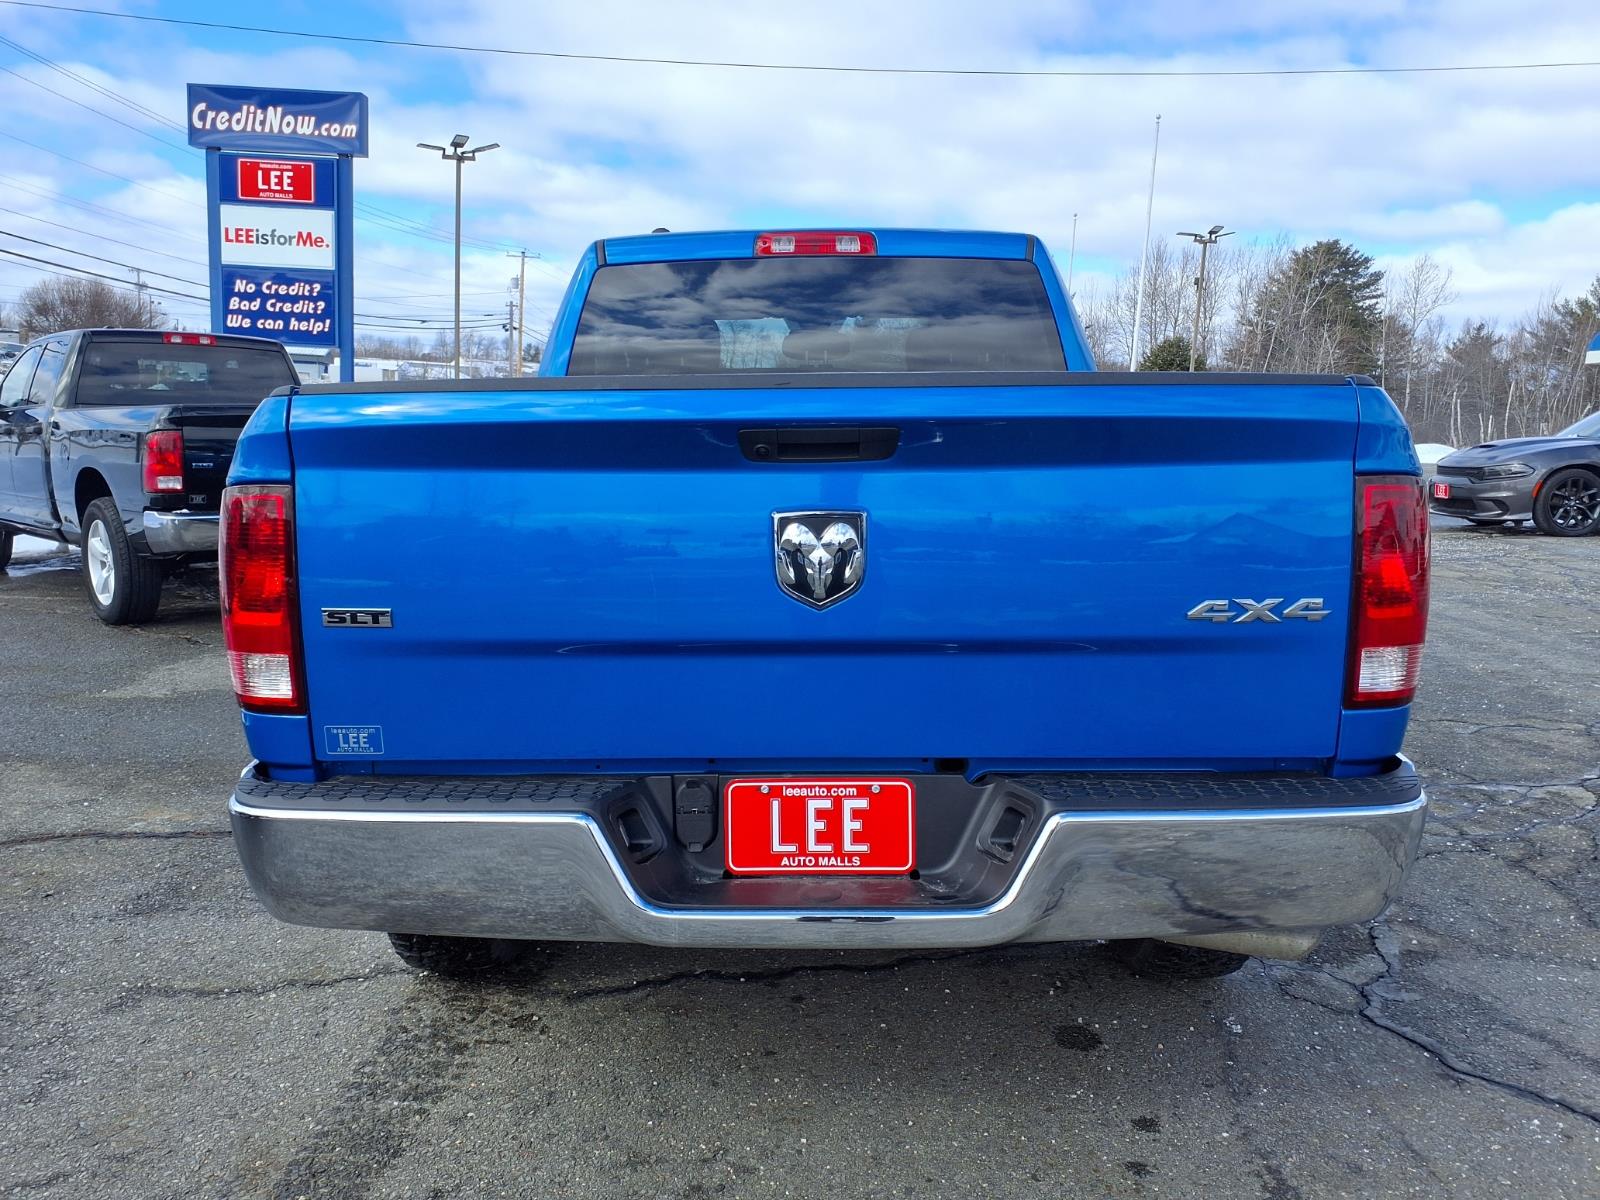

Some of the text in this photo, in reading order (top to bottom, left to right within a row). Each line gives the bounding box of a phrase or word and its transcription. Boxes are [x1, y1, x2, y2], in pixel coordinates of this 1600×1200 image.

[192, 102, 357, 138] CreditNow.com
[257, 170, 294, 190] LEE
[224, 226, 330, 248] LEEisforMe.
[234, 279, 321, 296] No Credit?
[229, 296, 325, 314] Bad Credit?
[226, 314, 331, 335] We can help!
[324, 609, 391, 625] SLT
[331, 727, 376, 735] leeauto.com
[338, 733, 370, 748] LEE
[782, 785, 857, 797] leeauto.com
[770, 797, 871, 854] LEE
[780, 856, 861, 867] AUTO MALLS
